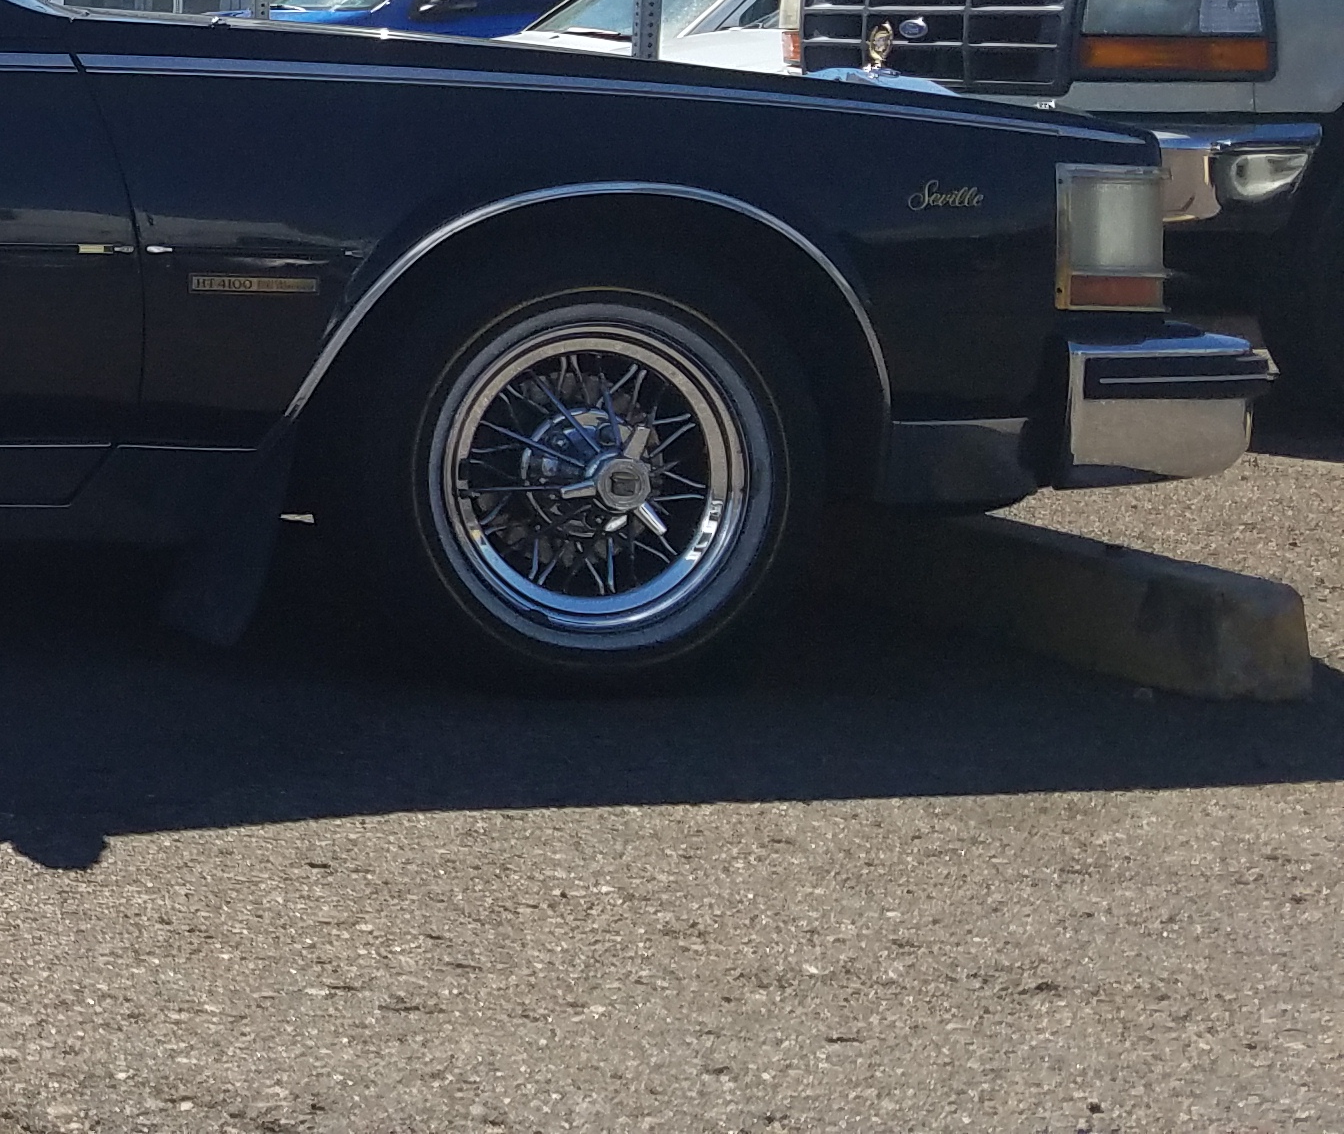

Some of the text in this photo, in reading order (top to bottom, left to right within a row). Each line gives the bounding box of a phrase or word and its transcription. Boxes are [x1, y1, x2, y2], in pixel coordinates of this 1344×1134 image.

[908, 179, 984, 211] Seville
[196, 278, 215, 289] HT
[217, 278, 253, 290] 4100
